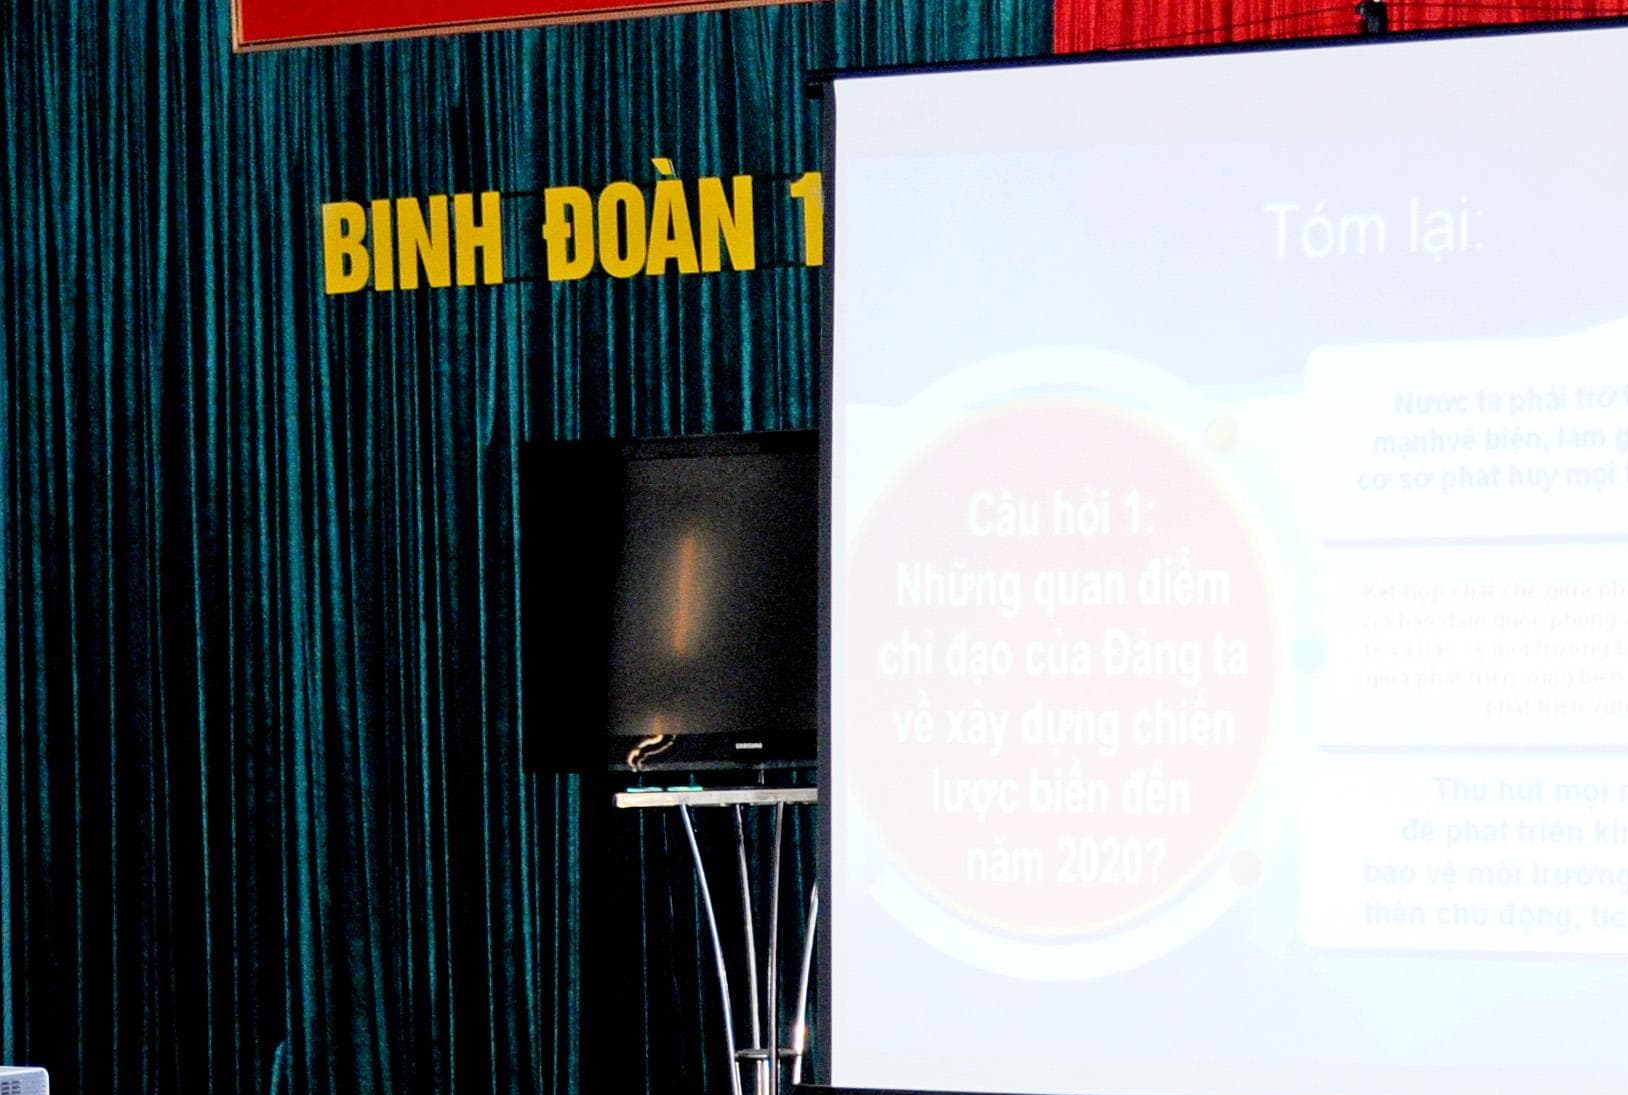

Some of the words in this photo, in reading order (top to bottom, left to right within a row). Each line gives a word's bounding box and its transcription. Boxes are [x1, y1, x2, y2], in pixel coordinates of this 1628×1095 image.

[323, 192, 503, 295] BINH
[543, 157, 755, 282] ĐOÀN
[1263, 198, 1388, 258] Tóm
[967, 488, 1040, 537] Câu
[1123, 488, 1155, 536] 1:
[896, 559, 1022, 619] Những
[1034, 568, 1127, 619] quan
[1138, 545, 1231, 606] điểm
[945, 631, 1013, 686] đạo
[1025, 627, 1091, 676] của
[1102, 626, 1201, 687] Đảng
[1213, 631, 1249, 676] ta
[892, 689, 935, 745] về
[946, 699, 1011, 757] xây
[1021, 699, 1121, 758] dựng
[1132, 688, 1236, 746] chiến
[931, 767, 1018, 824] lược
[1030, 757, 1110, 815] biển
[967, 837, 1045, 882] năm
[1056, 835, 1168, 885] 2020?
